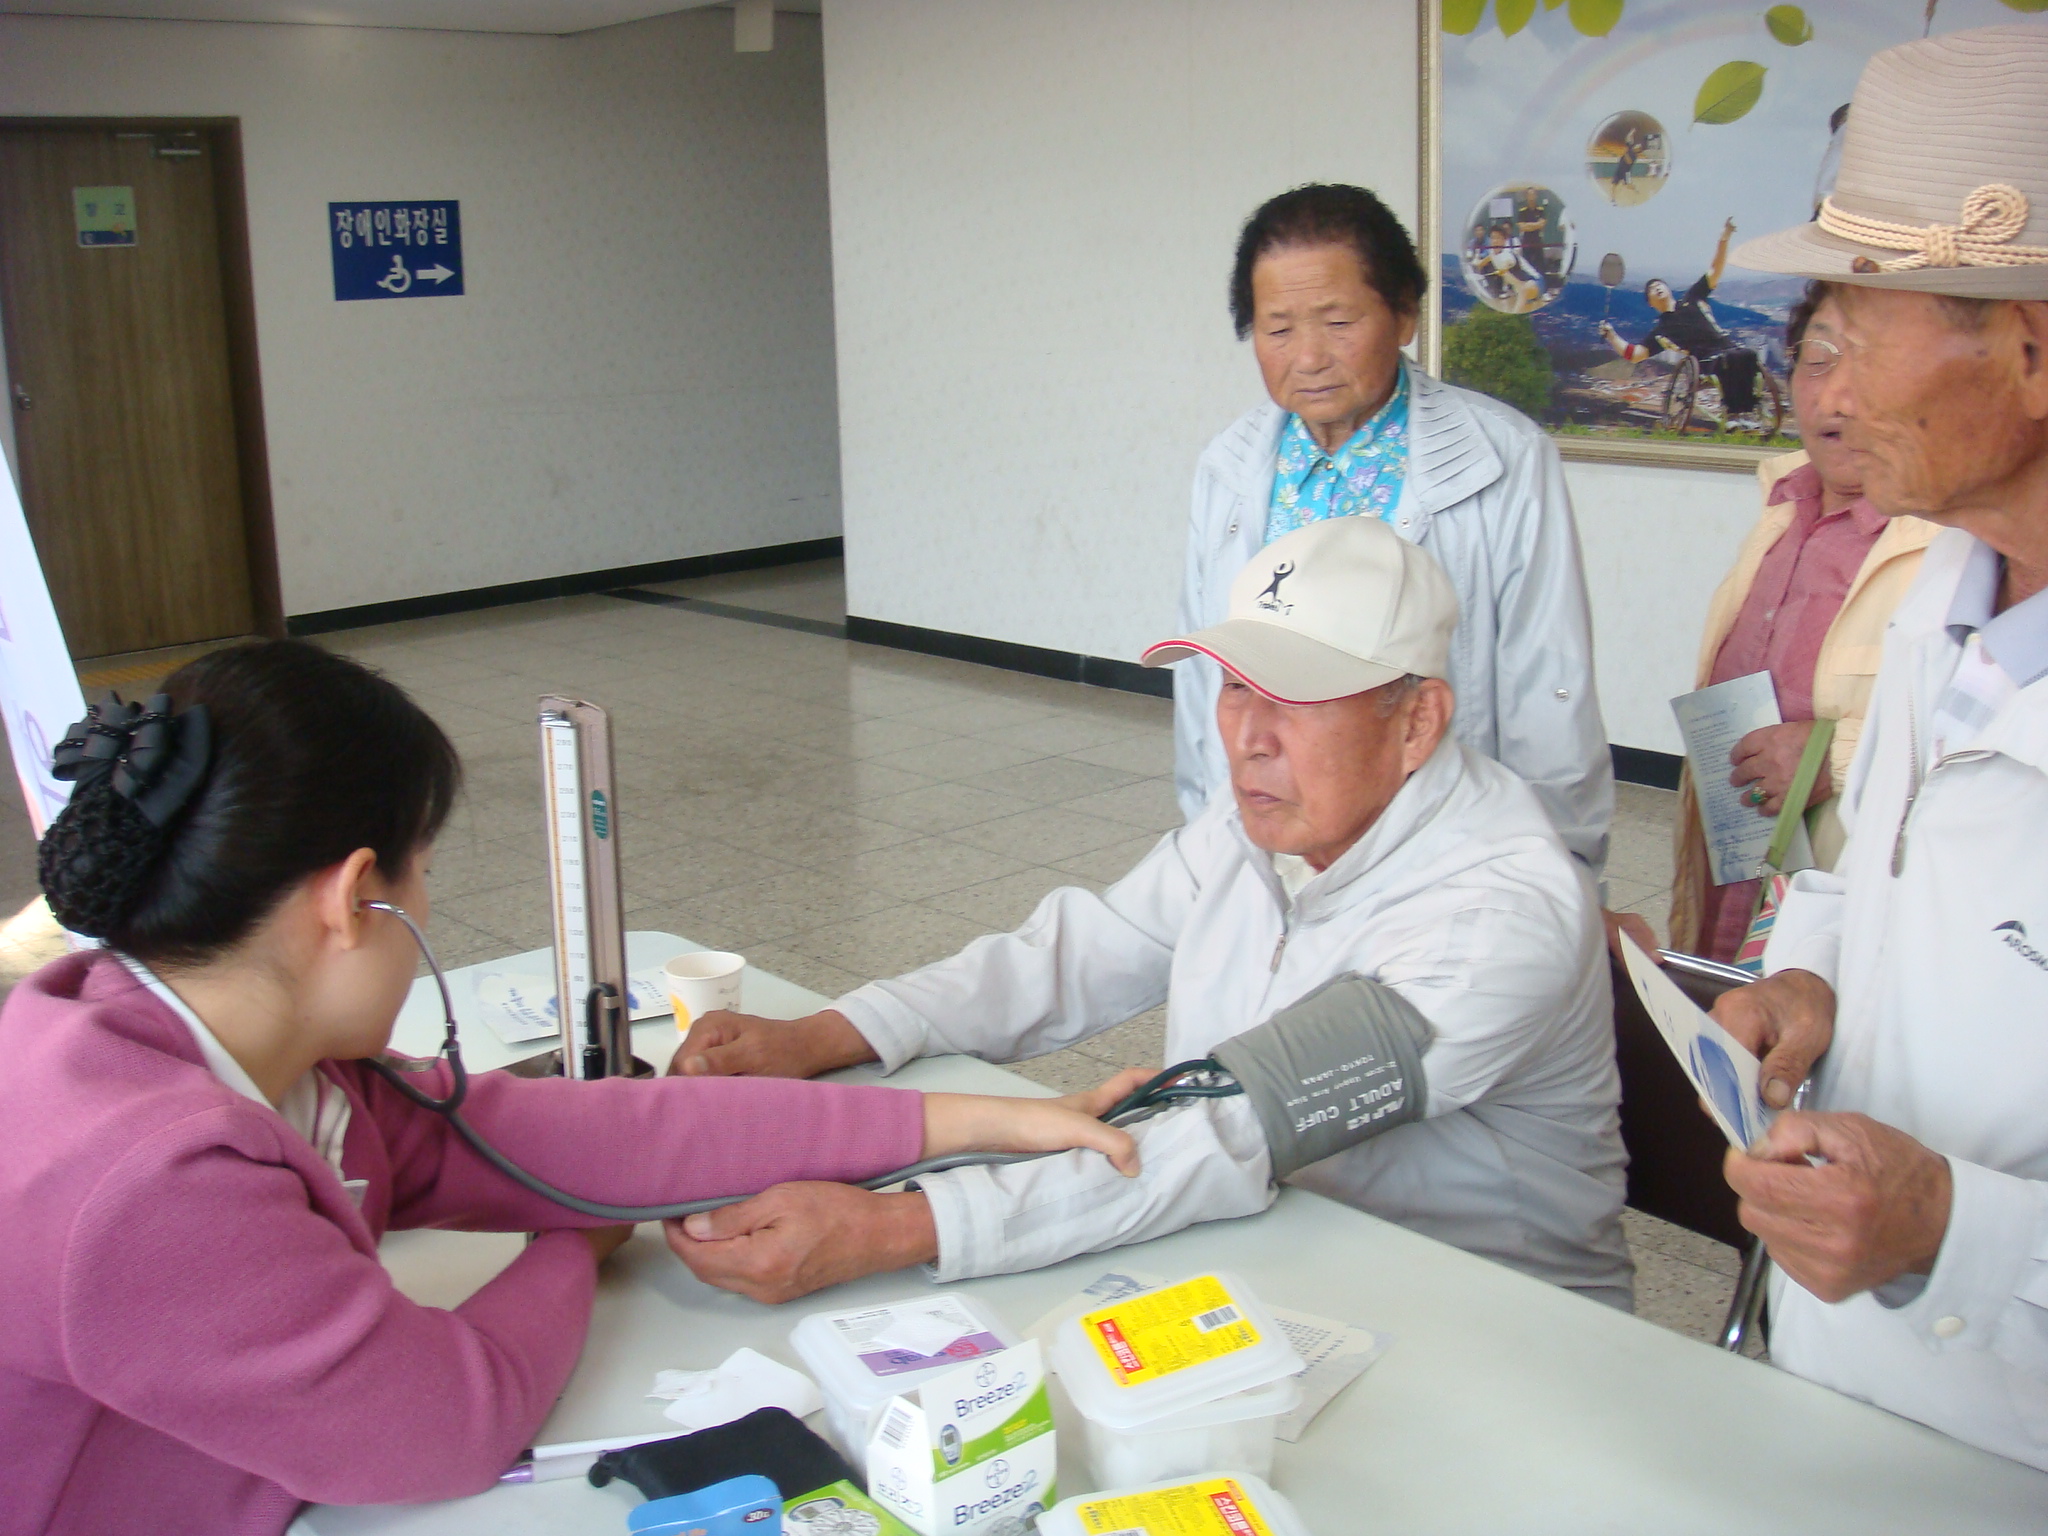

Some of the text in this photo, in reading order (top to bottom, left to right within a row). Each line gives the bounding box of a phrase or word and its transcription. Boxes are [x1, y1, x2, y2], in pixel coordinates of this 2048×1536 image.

[335, 207, 448, 248] 장애인화장실
[1295, 1077, 1404, 1133] ADULT CUFF
